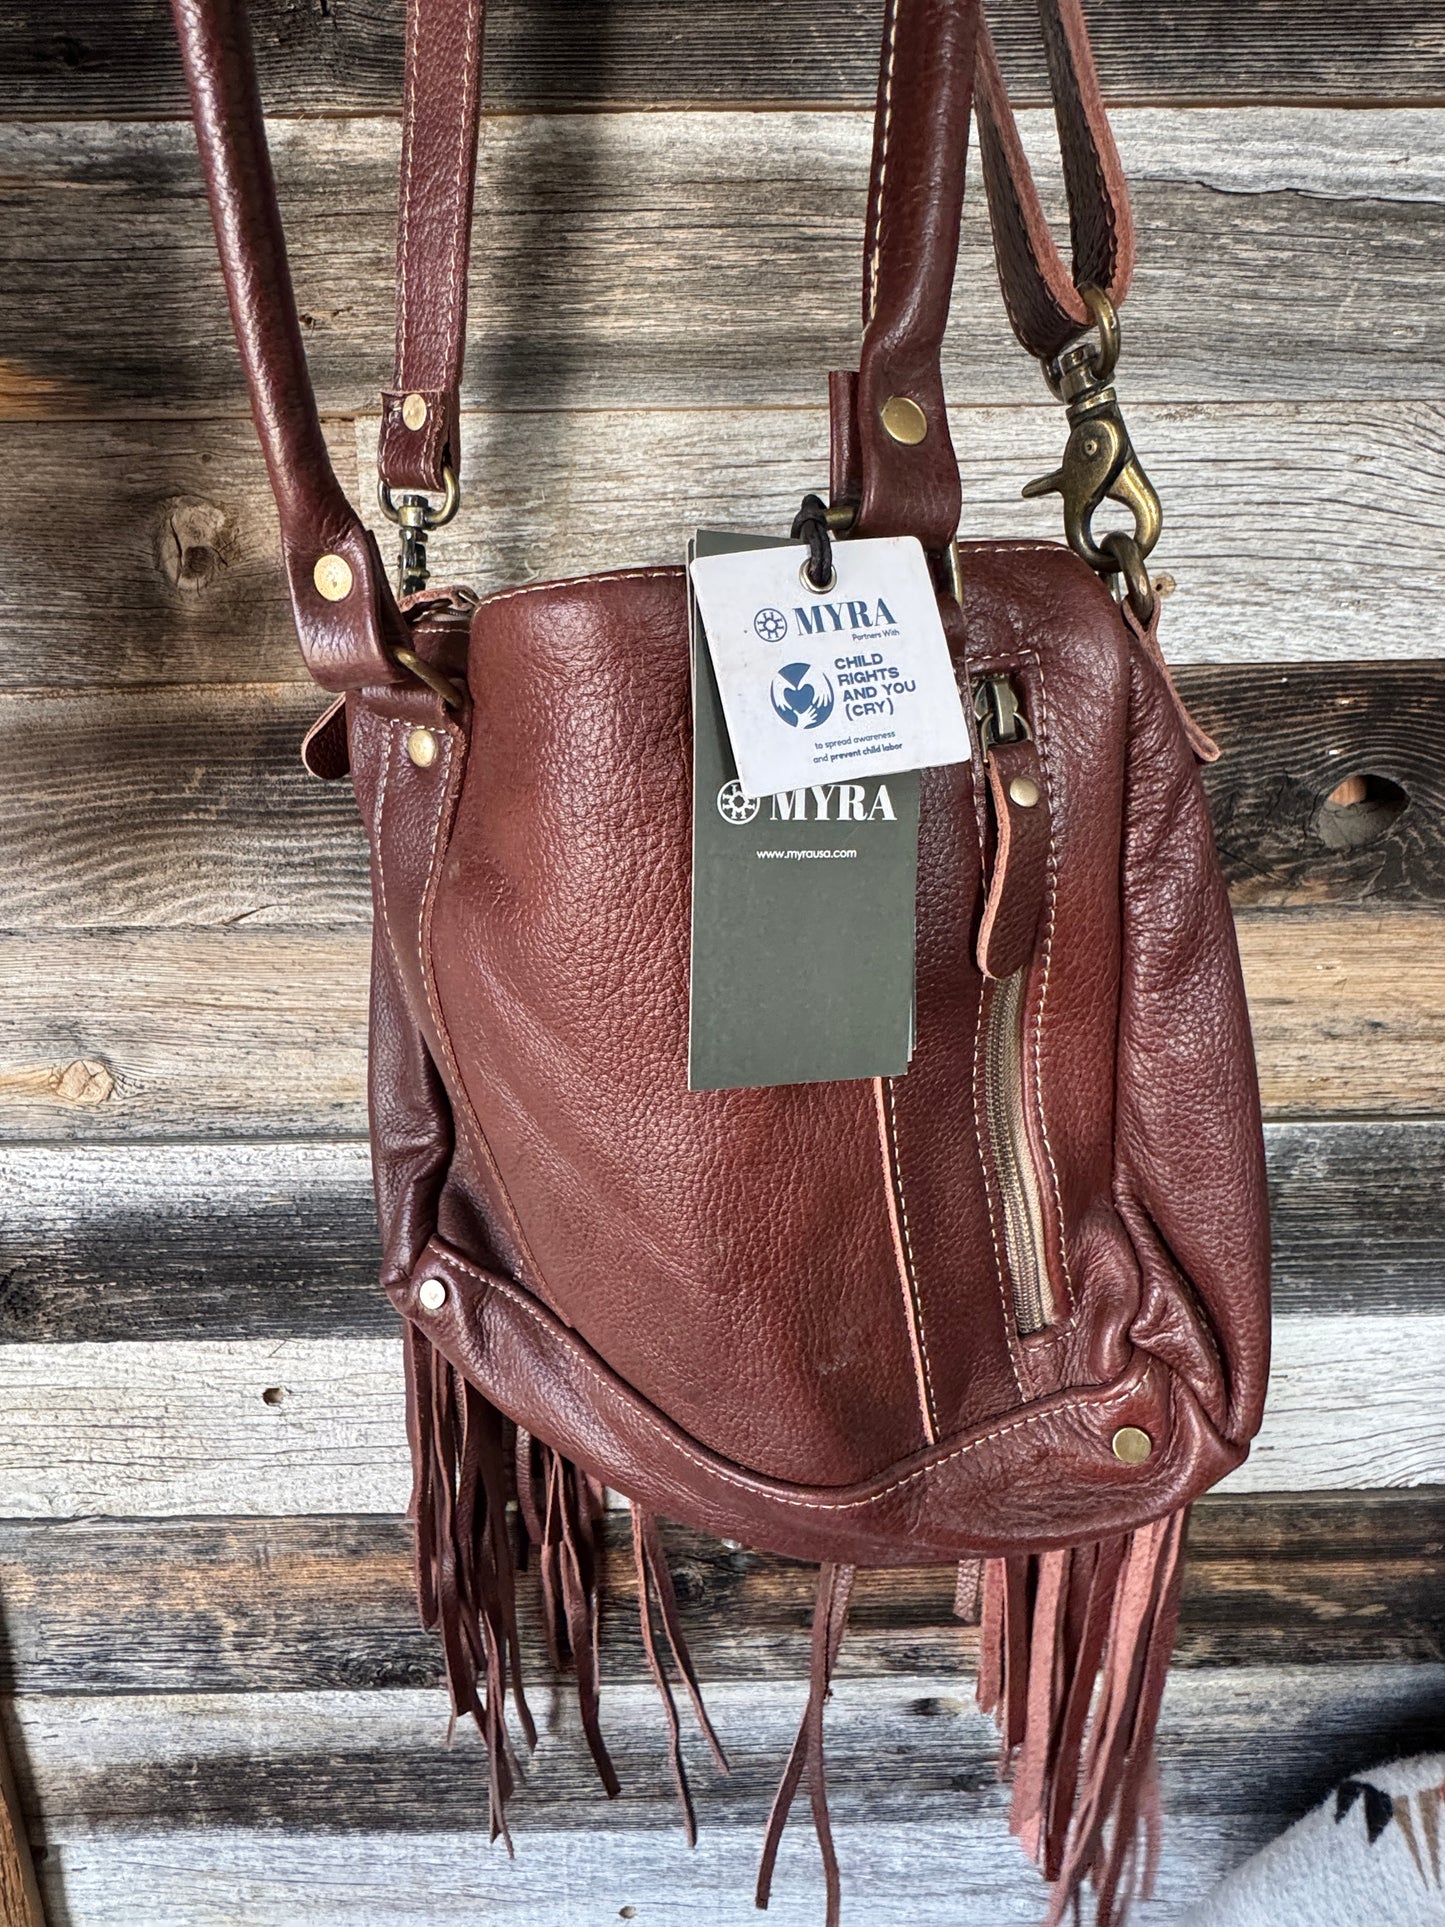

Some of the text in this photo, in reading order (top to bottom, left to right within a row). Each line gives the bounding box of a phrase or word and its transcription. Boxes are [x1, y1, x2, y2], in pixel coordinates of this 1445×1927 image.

[792, 598, 898, 636] MYRA
[852, 628, 900, 642] Partners With
[834, 653, 883, 670] CHILD
[837, 666, 900, 687] RIGHTS
[843, 680, 916, 702] AND YOU
[845, 697, 894, 721] (CRY)
[815, 731, 896, 750] to spread awareness
[813, 743, 903, 764] and prevent child labor
[769, 784, 897, 821] MYRA
[756, 849, 857, 861] www.myrausa.com
